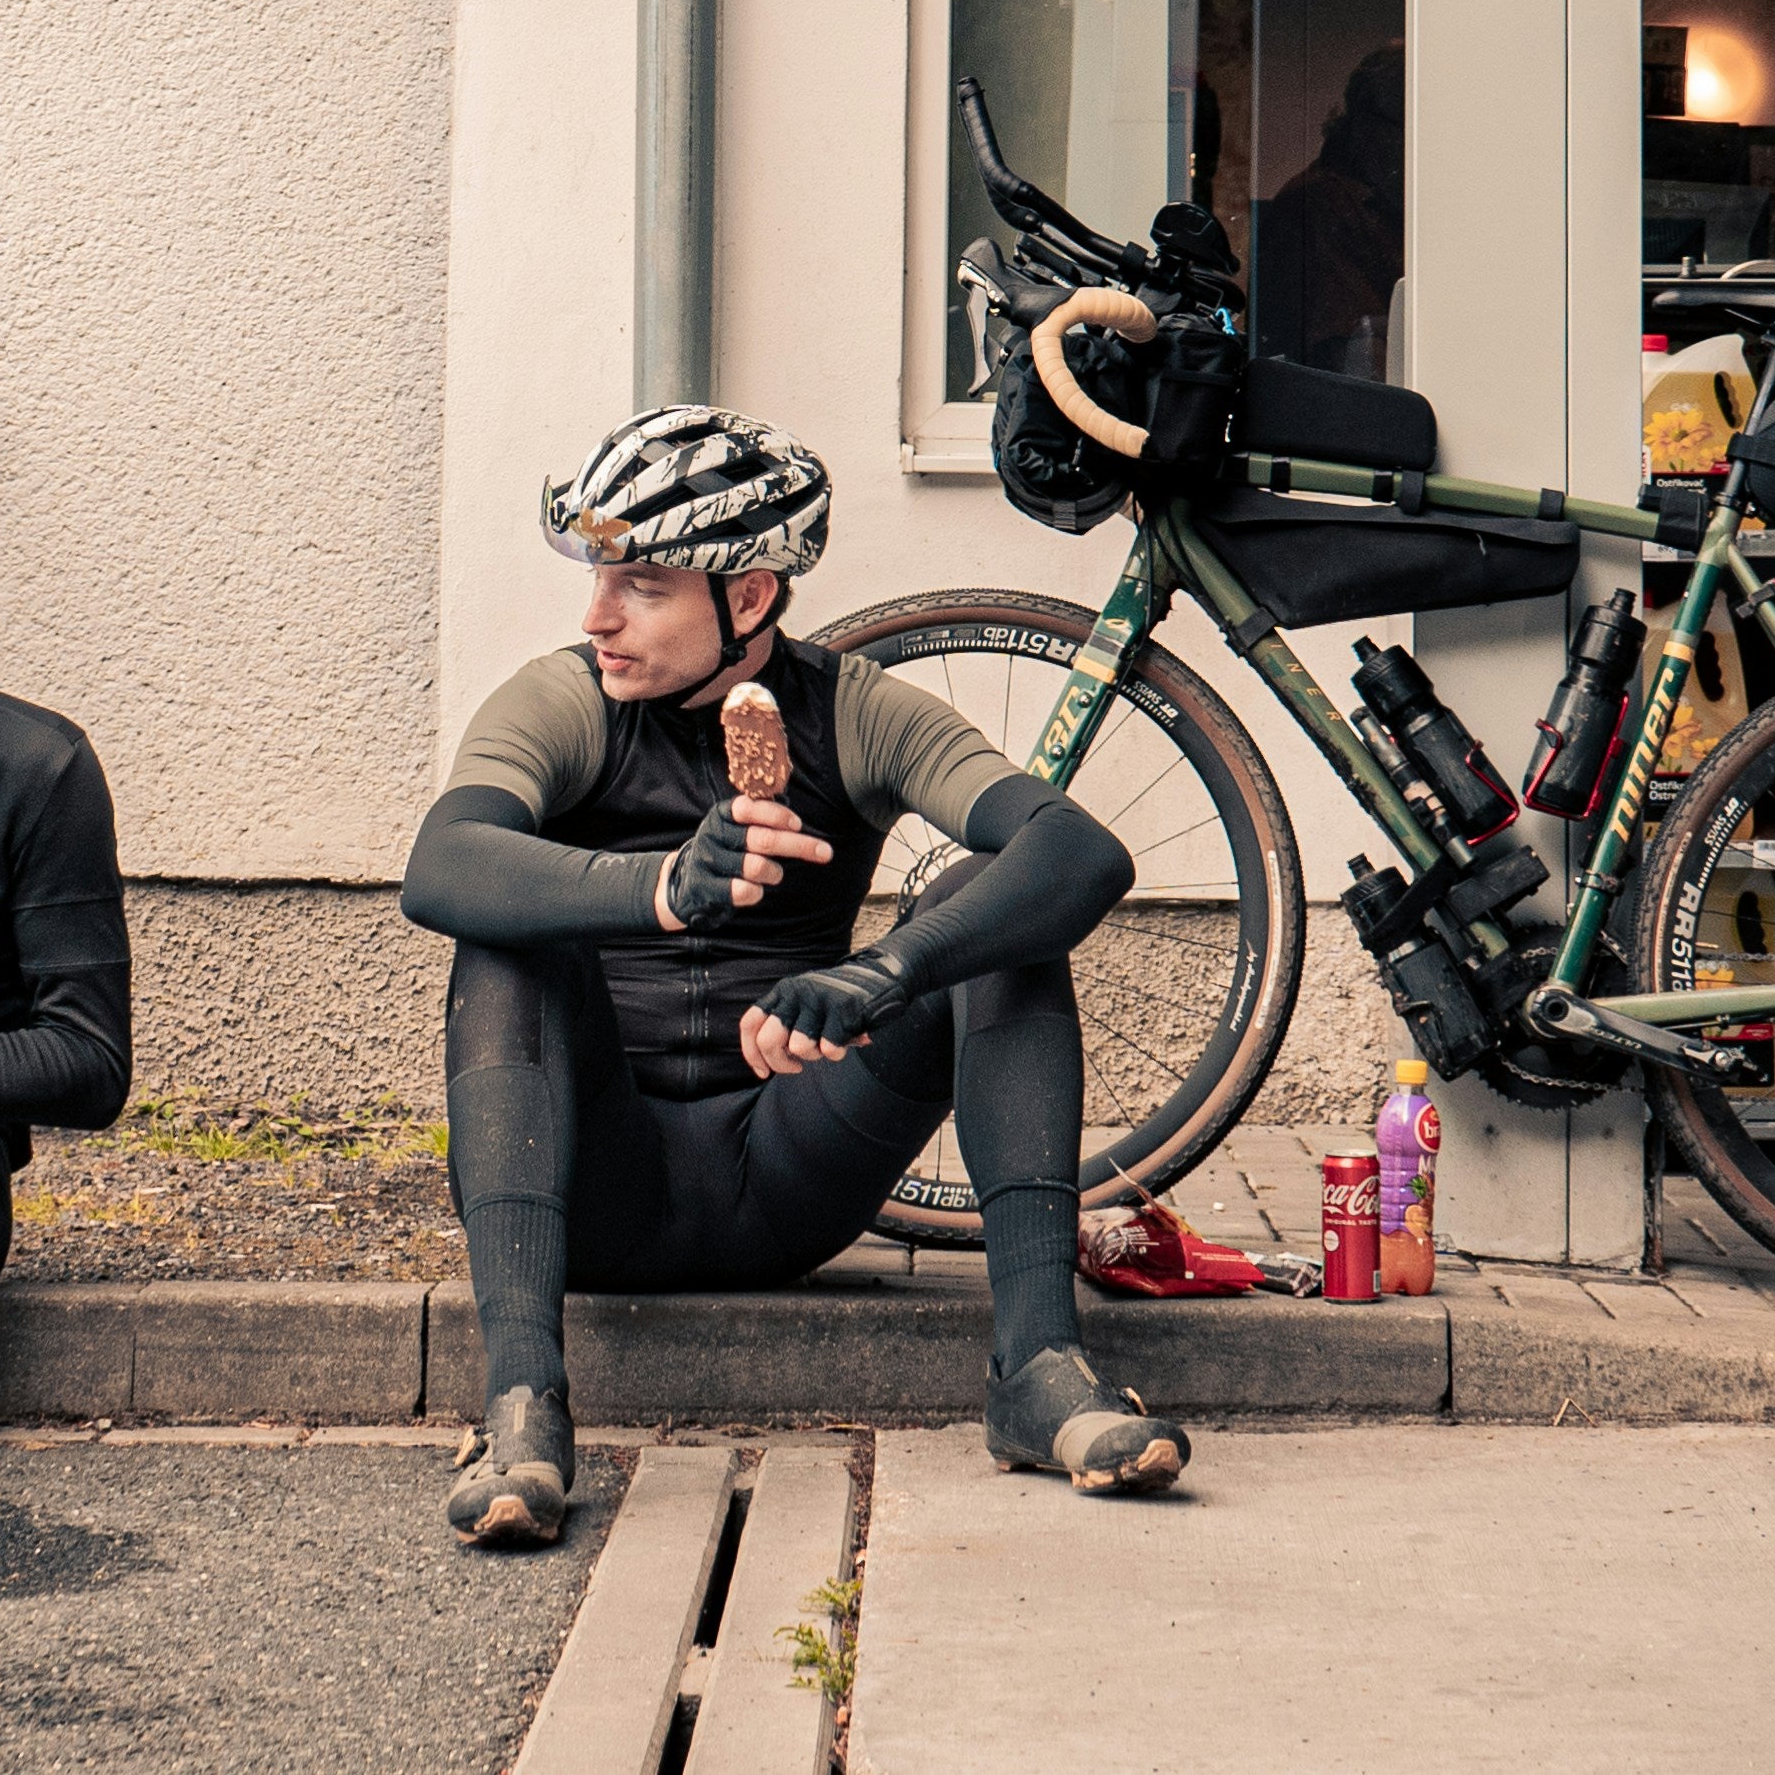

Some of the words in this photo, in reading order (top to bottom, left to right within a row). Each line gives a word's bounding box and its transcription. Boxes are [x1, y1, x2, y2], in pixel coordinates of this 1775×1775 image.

[1133, 680, 1163, 705] SWISS
[1723, 796, 1739, 816] DT
[1704, 813, 1728, 846] SWISS
